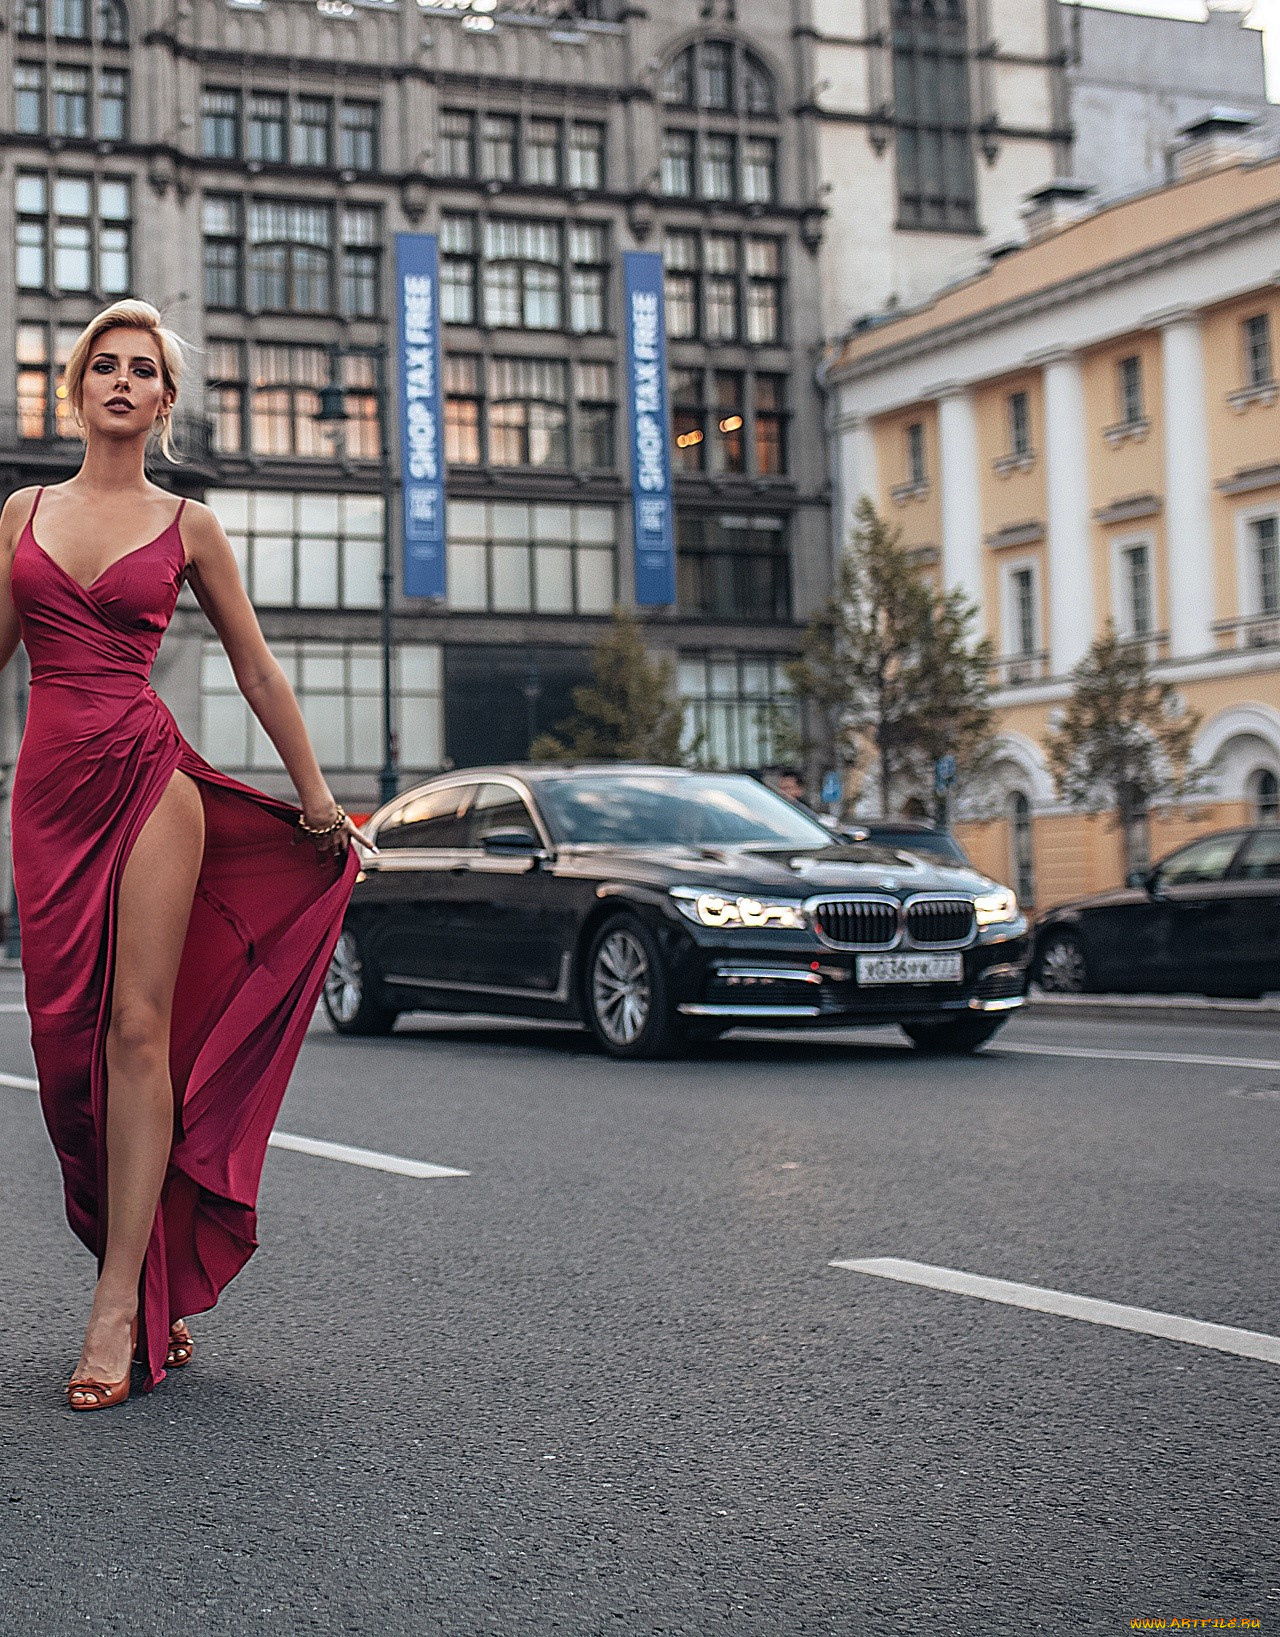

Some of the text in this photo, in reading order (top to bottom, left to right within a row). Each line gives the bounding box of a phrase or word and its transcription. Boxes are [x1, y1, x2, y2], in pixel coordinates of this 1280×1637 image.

[403, 275, 432, 344] FREE
[632, 292, 658, 360] FREE
[405, 345, 433, 401] TAX
[634, 361, 660, 413] TAX
[407, 402, 437, 480] SHOP
[636, 414, 665, 492] SHOP
